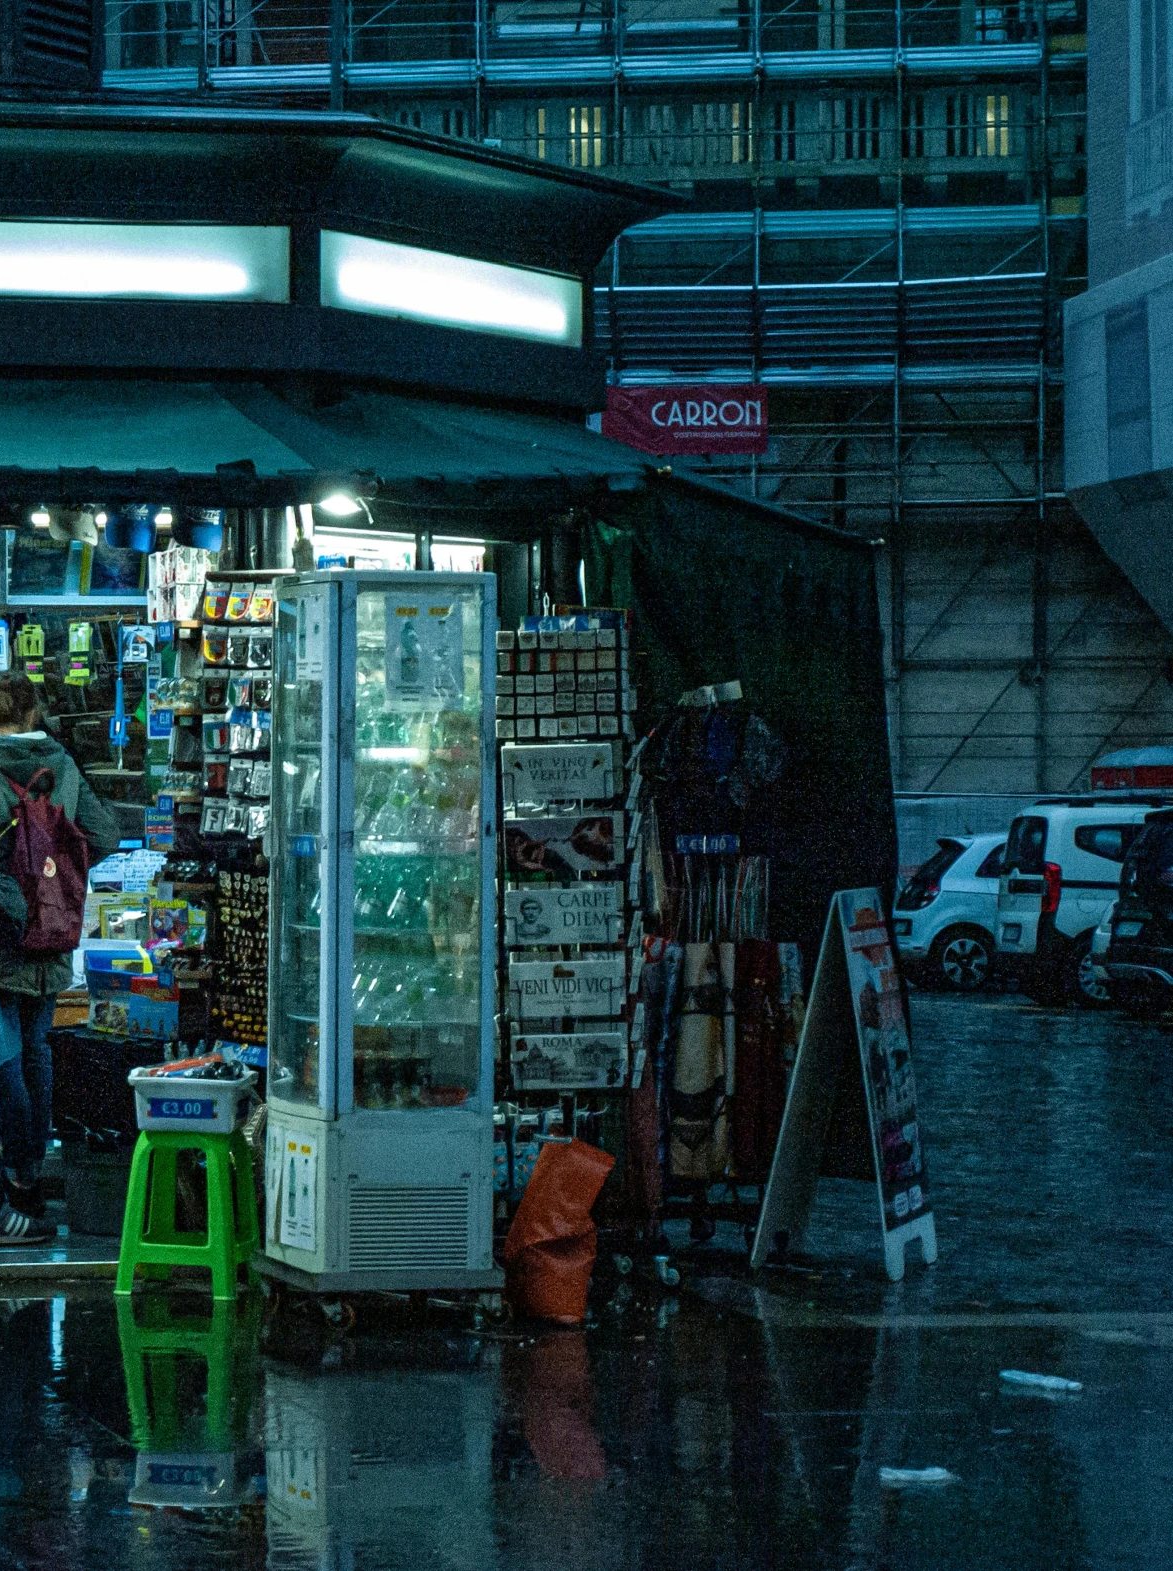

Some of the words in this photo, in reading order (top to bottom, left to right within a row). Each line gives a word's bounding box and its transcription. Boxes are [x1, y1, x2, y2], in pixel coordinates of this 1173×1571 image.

[651, 399, 762, 427] CARRON
[529, 769, 587, 782] VERITAS
[557, 892, 613, 908] CARPE
[563, 911, 609, 928] DIEM
[515, 979, 548, 995] VENI
[553, 978, 581, 994] VIDI
[541, 1036, 583, 1048] ROMA
[161, 1101, 202, 1117] €3,00
